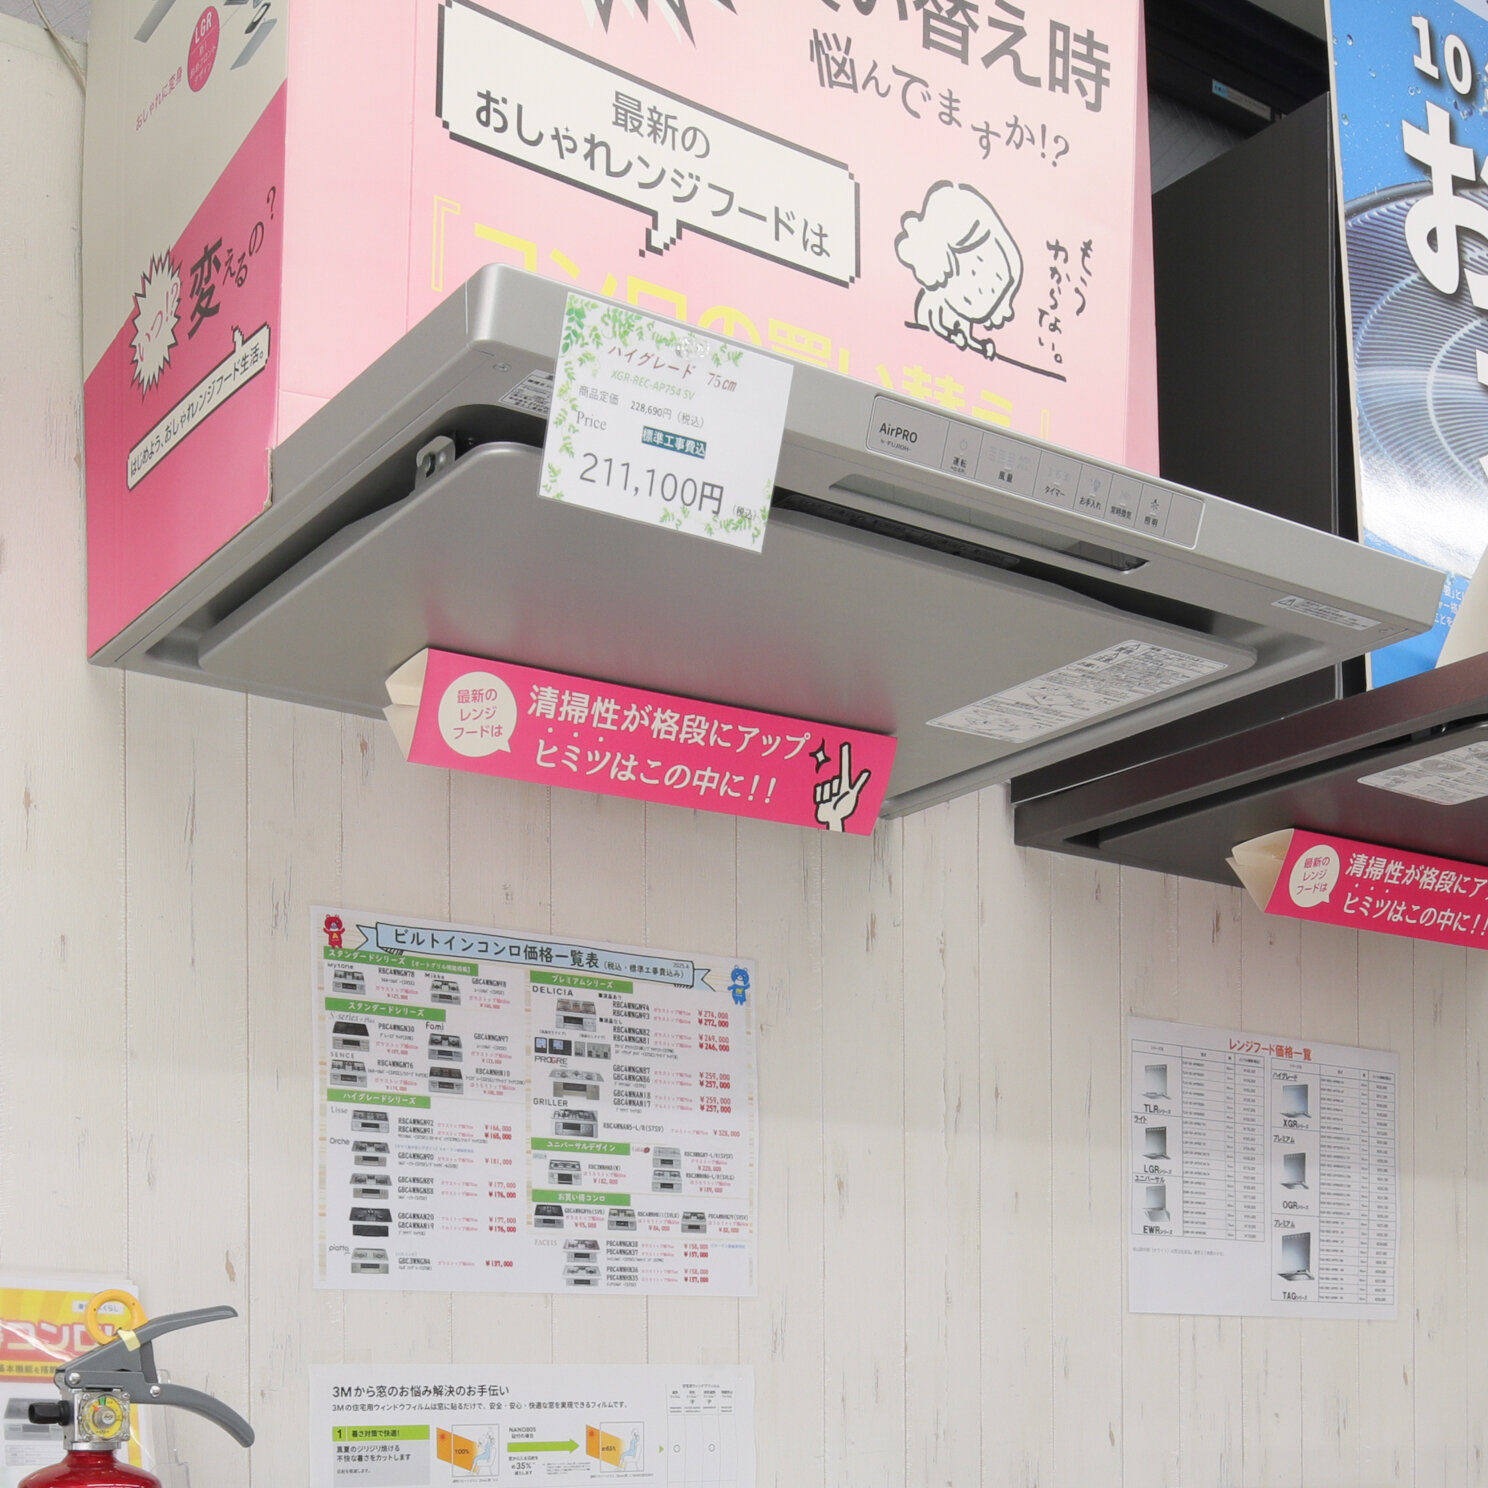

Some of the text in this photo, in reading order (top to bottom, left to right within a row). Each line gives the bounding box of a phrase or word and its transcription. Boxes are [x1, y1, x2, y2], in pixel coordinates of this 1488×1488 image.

[195, 11, 212, 44] LGR
[611, 90, 710, 159] 最新の
[476, 89, 832, 257] おしゃれレンジフードは
[608, 345, 696, 379] ハイグレード
[578, 385, 619, 406] 商品定価
[576, 410, 607, 431] Price
[879, 422, 918, 444] AirPRO
[642, 427, 706, 457] 標準工事費込
[580, 452, 724, 515] 211,100円
[1144, 517, 1158, 528] 照明
[457, 688, 498, 704] 最新の
[458, 706, 497, 722] レンジ
[527, 684, 813, 760] 清掃性が格段にアップ
[453, 725, 503, 740] フードは
[1304, 856, 1330, 868] 最新の
[1303, 869, 1327, 880] レンジ
[1297, 883, 1328, 895] フードは
[394, 928, 599, 970] ビルトインコンロ価格一覧表
[329, 951, 406, 965] スタンダードシリーズ
[552, 974, 613, 989] プレミアムシリーズ
[532, 985, 574, 997] DELICIA
[348, 1002, 424, 1017] スタンダードシリーズ
[1229, 1038, 1312, 1061] レンジフード価格一覧
[534, 1056, 568, 1065] PROGRE
[343, 1092, 416, 1105] ハイグレードシリーズ
[533, 1098, 568, 1107] GRILLER
[547, 1140, 616, 1152] ユニバーサルデザイン
[336, 1429, 343, 1439] 1
[336, 1445, 400, 1454] 真夏のジリジリ焼ける
[336, 1453, 411, 1463] 不快な暑さをカットします
